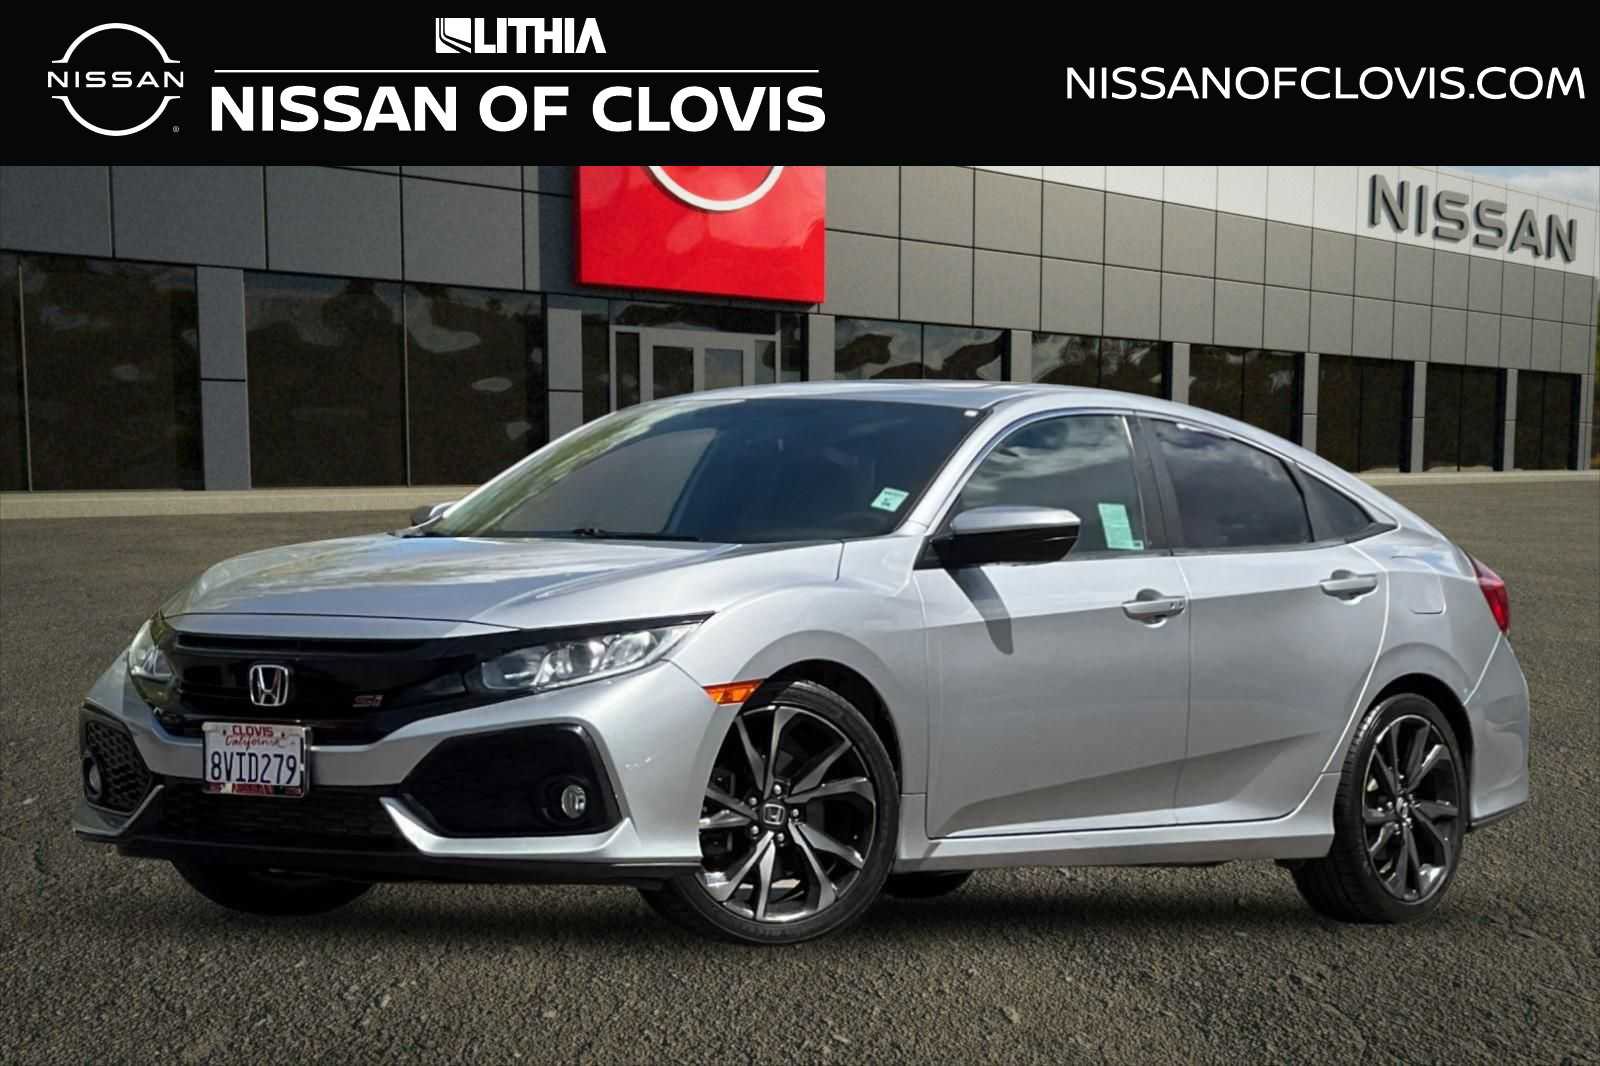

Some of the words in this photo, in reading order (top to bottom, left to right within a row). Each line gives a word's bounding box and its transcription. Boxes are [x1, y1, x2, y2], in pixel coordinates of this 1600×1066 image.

[1368, 174, 1577, 264] NISSAN
[231, 725, 273, 737] CLOVIS
[210, 750, 298, 785] 8VID279
